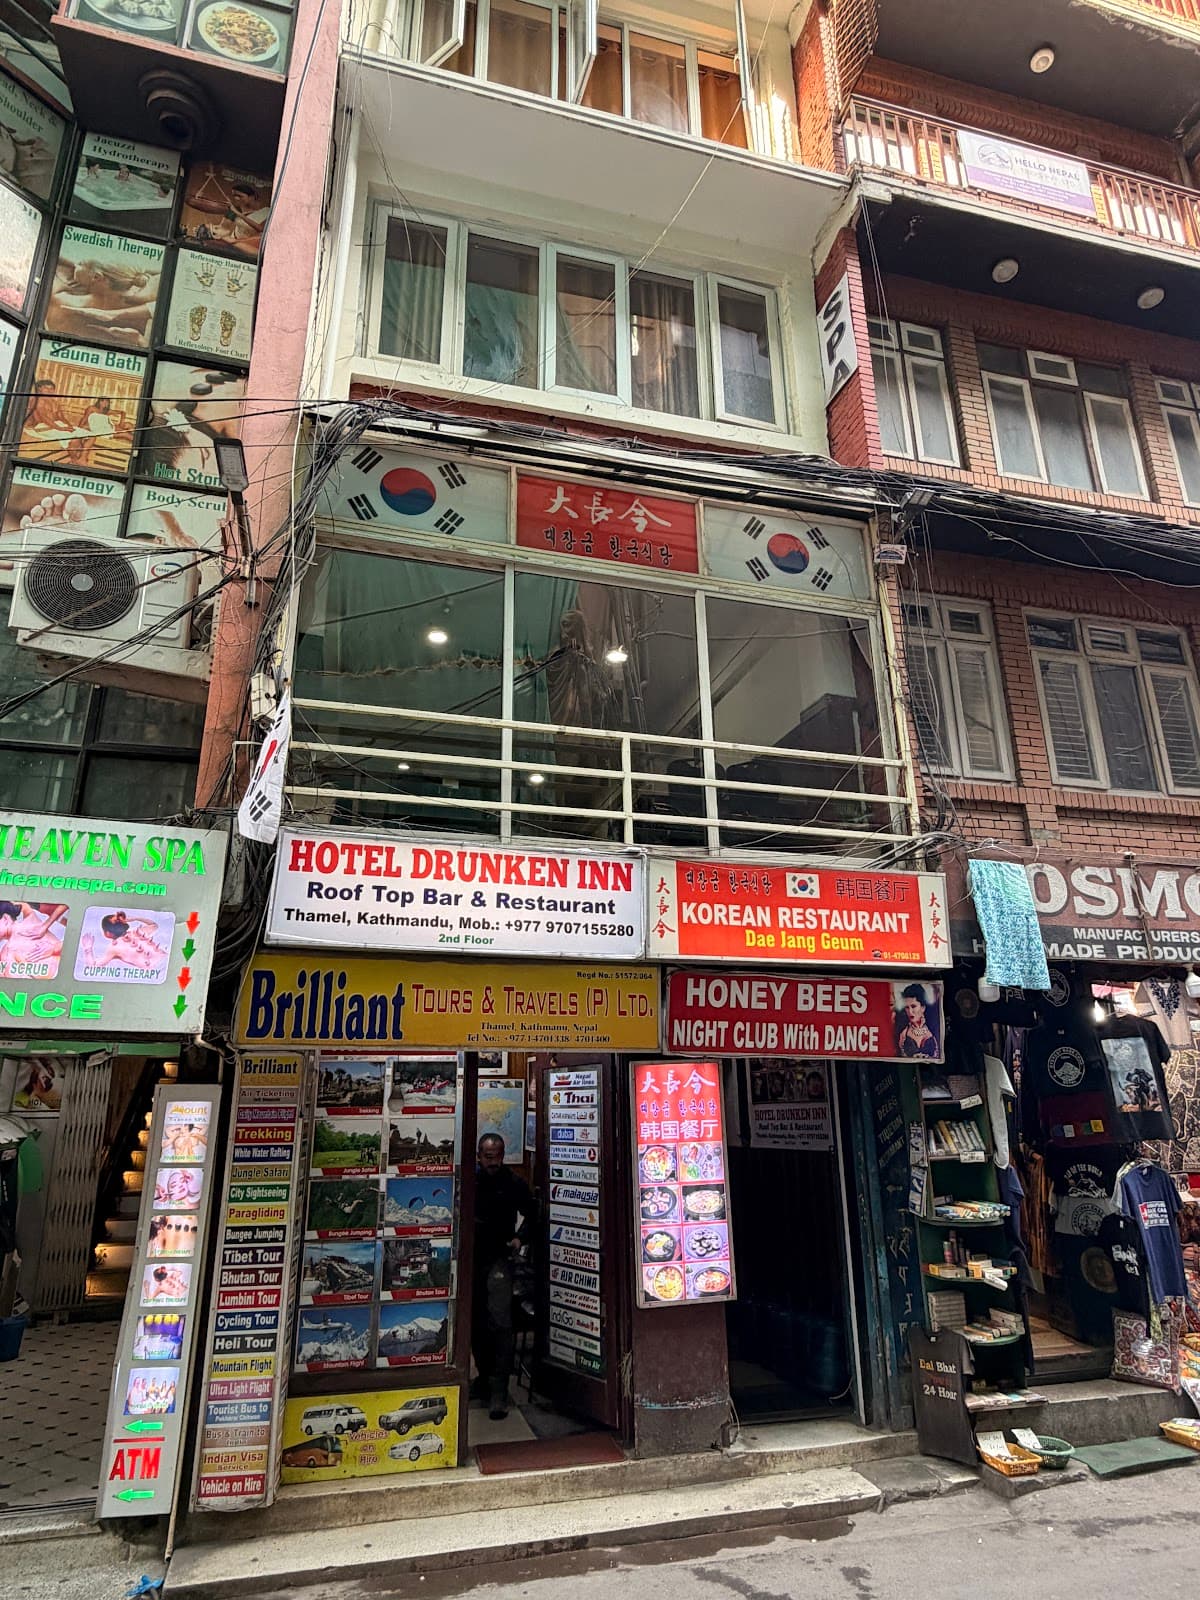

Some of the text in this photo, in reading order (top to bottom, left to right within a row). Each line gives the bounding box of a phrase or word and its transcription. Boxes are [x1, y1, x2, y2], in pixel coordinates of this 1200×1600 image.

[92, 145, 171, 171] Hydrotherapy
[1014, 156, 1047, 172] HELLO
[1048, 167, 1081, 181] NEPAL
[64, 226, 164, 261] Swedish Therapy
[823, 289, 851, 399] SPA
[49, 341, 142, 372] Sauna Bath
[20, 466, 115, 494] Reflexology
[153, 462, 224, 488] Hot Ston
[146, 490, 226, 512] Body Scru
[544, 485, 673, 534] 大長今
[143, 835, 207, 876] SPA
[288, 839, 634, 892] HOTEL DRUNKEN INN
[307, 881, 616, 915] Roof Top Bar & Restaurant
[834, 877, 911, 902] 韩国餐厅
[284, 908, 635, 937] Thamel, Kathmandu, Mob.: +977 9707155280
[681, 902, 910, 934] KOREAN RESTAURANT
[438, 933, 495, 946] 2nd Floor
[745, 929, 864, 954] Dae Jang Geum
[10, 961, 49, 976] SCRUB
[83, 965, 161, 980] CUPPING THERAPY
[685, 977, 869, 1014] HONEY BEES
[245, 968, 406, 1041] Brilliant
[412, 983, 473, 1015] TOURS
[482, 985, 496, 1015] &
[504, 986, 579, 1017] TRAVELS
[586, 986, 610, 1018] (P)
[673, 1018, 880, 1053] NIGHT CLUB With DANCE
[243, 1058, 298, 1074] Brilliant
[639, 1069, 717, 1096] 大長今
[564, 1091, 595, 1104] Thai
[237, 1128, 292, 1141] Trekking
[639, 1119, 719, 1141] 韩国餐厅
[234, 1147, 291, 1160] White Water Rafting
[232, 1167, 288, 1180] Jungle Safari
[230, 1186, 287, 1200] City Sightseeing
[229, 1207, 285, 1221] Paragliding
[226, 1227, 284, 1242] Bungee Jumping
[224, 1249, 282, 1263] Tibet Tour
[562, 1257, 598, 1269] AIRLINES
[563, 1248, 596, 1261] SICHUAN
[221, 1270, 280, 1285] Bhutan Tour
[560, 1269, 598, 1289] AIR CHINA
[219, 1291, 278, 1307] Lumbini Tour
[217, 1313, 276, 1329] Cycling Tour
[215, 1336, 274, 1351] Heli Tour
[212, 1358, 272, 1374] Mountain Flight
[918, 1358, 957, 1374] Dal Bhat
[209, 1381, 270, 1398] Ultra Light Flight
[922, 1383, 958, 1401] 24 Hour
[208, 1402, 268, 1416] Tourist Bus to
[206, 1429, 222, 1440] Bus
[109, 1447, 161, 1481] ATM
[203, 1451, 264, 1464] Indian Visa
[200, 1477, 262, 1494] Vehicle on Hire
